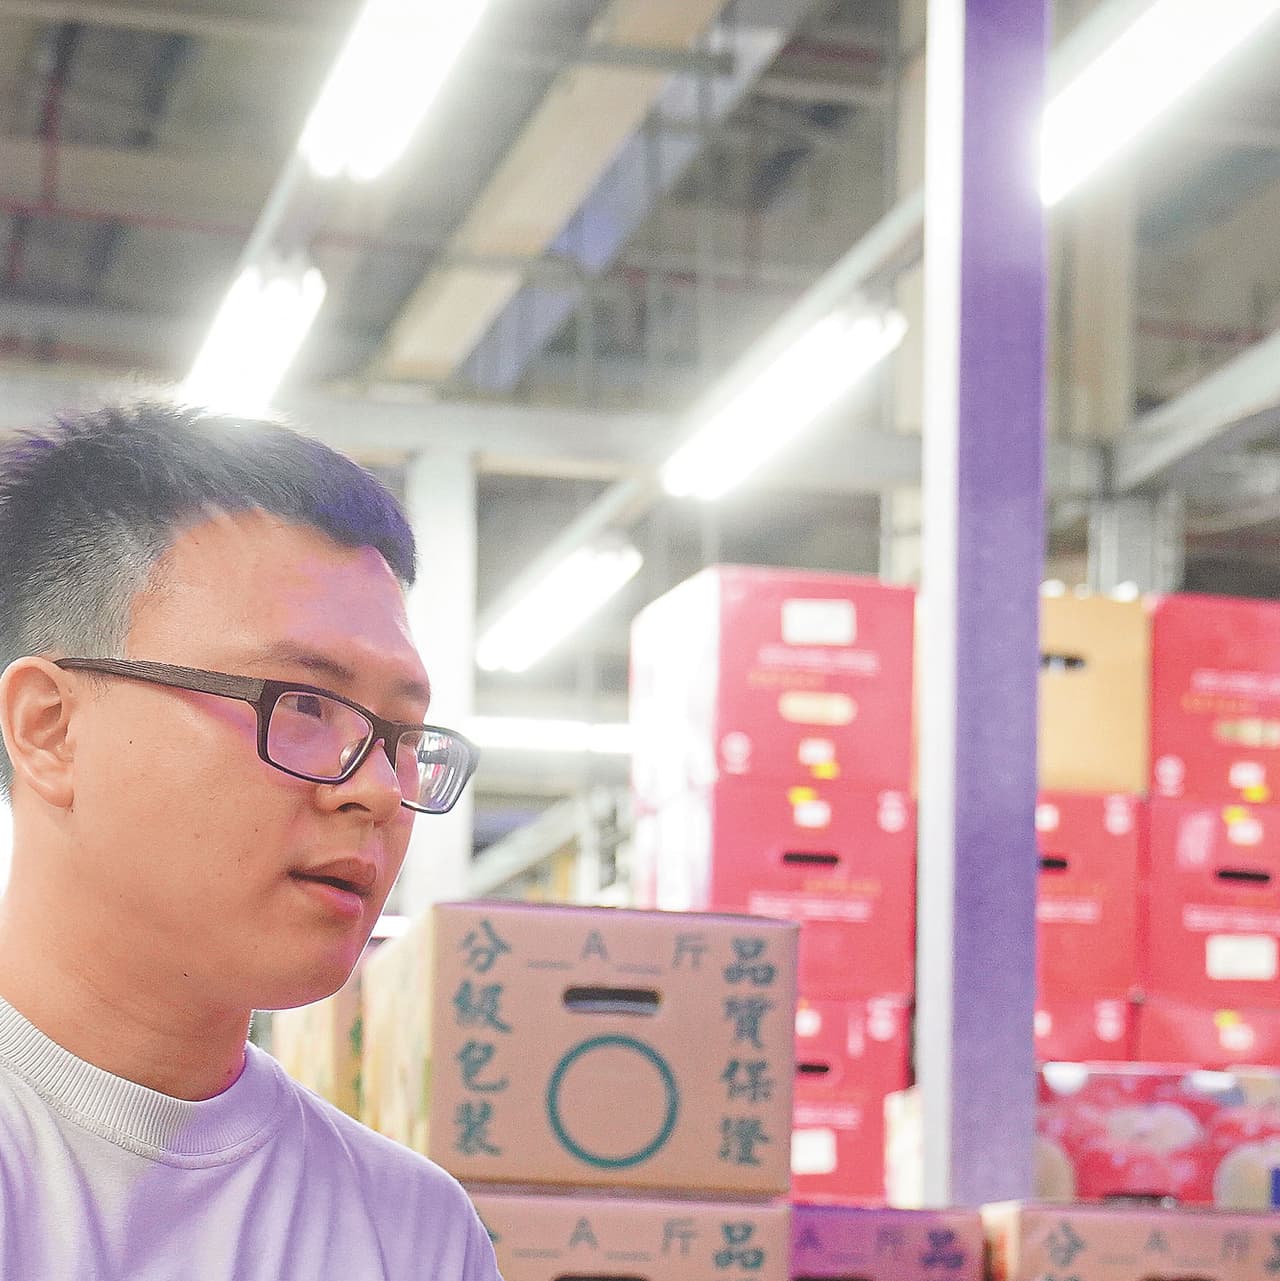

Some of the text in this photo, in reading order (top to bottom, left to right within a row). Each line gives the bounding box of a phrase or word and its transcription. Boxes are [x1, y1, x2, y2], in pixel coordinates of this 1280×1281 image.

[581, 929, 709, 971] A 斤
[451, 919, 513, 1156] 分級包裝
[721, 936, 776, 1168] 品質保證
[569, 1216, 697, 1256] A 斤
